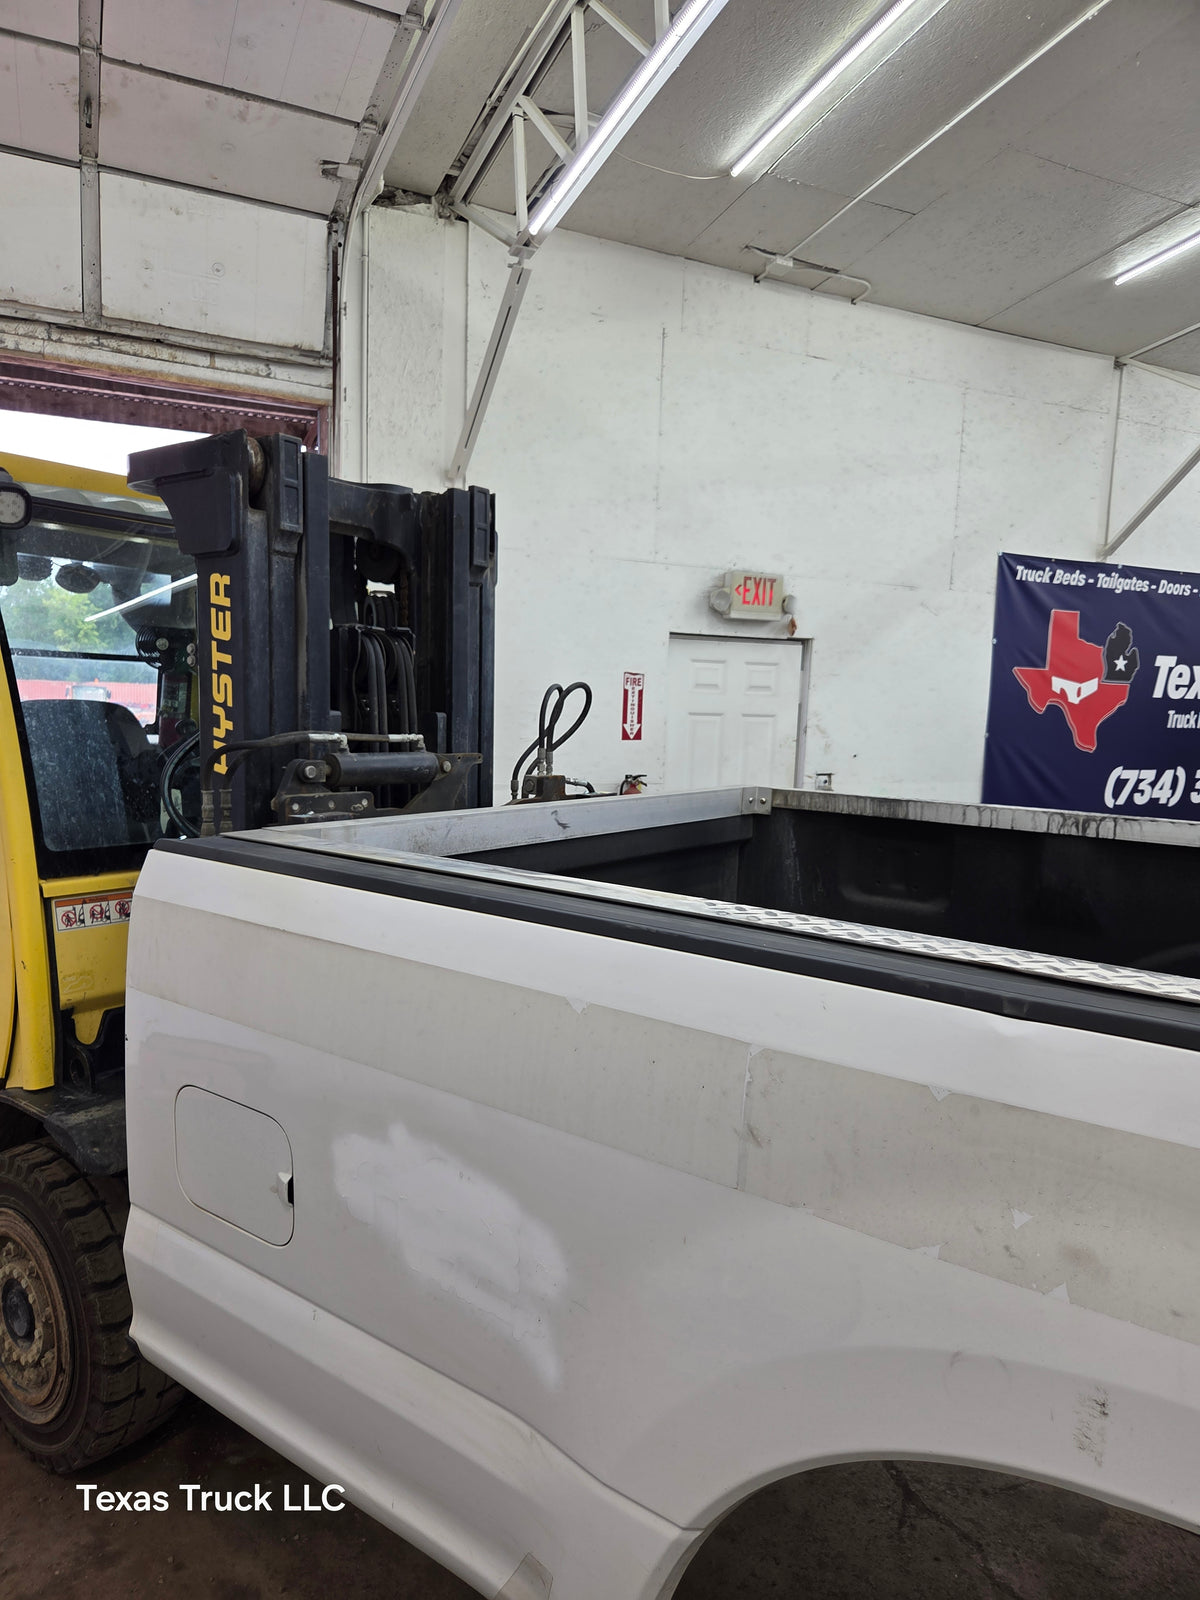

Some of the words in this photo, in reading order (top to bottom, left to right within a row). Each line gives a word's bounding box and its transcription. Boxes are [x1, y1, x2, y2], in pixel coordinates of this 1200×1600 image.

[742, 576, 777, 606] EXIT
[1016, 565, 1053, 583] Truck
[1053, 569, 1086, 586] Beds
[1096, 572, 1150, 593] Tailgates
[1157, 579, 1191, 596] Doors
[625, 677, 642, 686] FIRE
[1167, 710, 1197, 729] Truck
[1104, 766, 1186, 809] (734)
